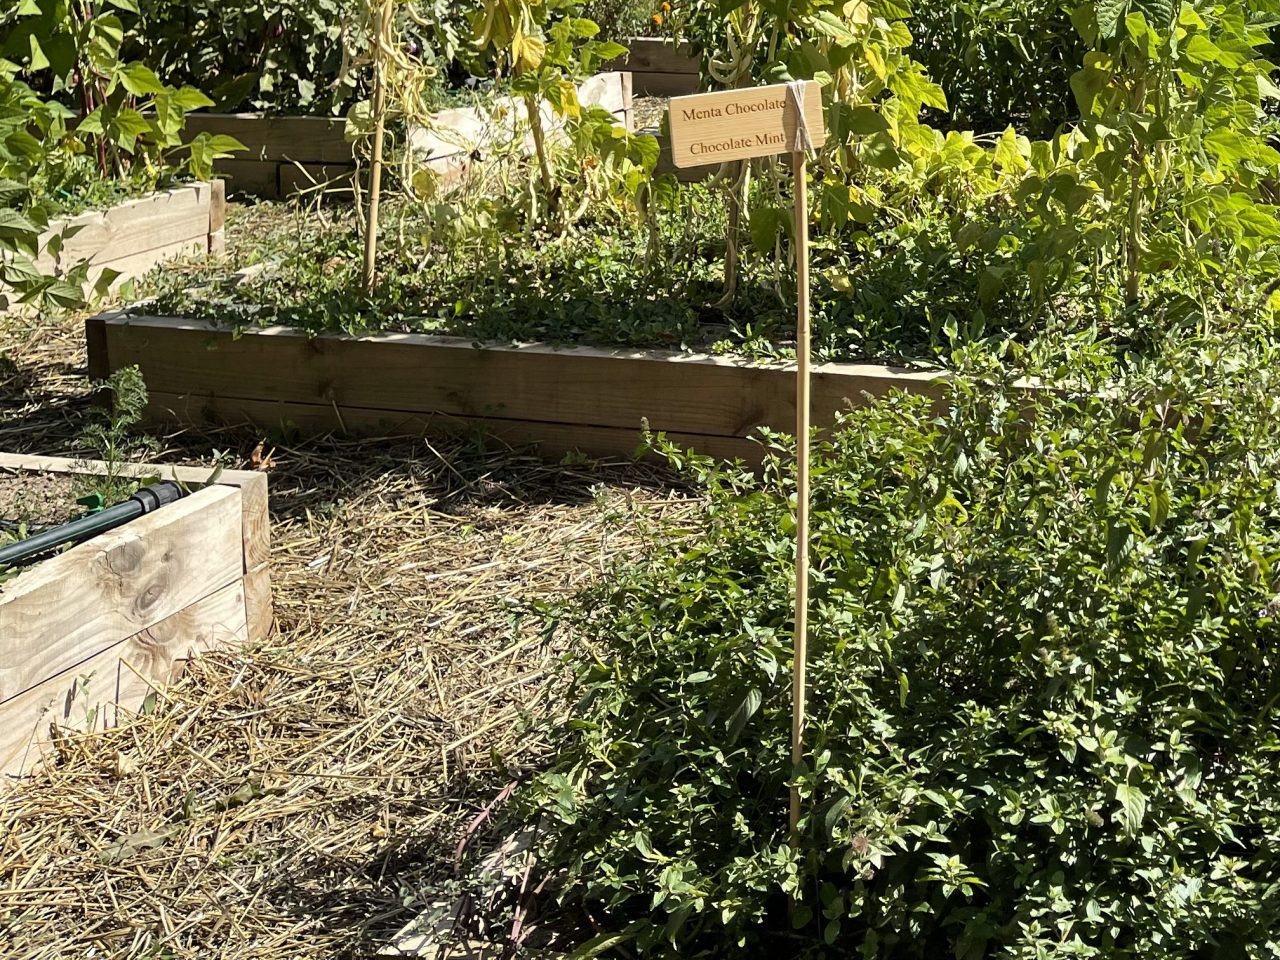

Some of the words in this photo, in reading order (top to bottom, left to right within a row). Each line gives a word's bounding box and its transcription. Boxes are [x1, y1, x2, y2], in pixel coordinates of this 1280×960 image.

[682, 107, 722, 121] Menta
[725, 99, 786, 116] Chocolate
[690, 138, 751, 155] Chocolate
[755, 133, 785, 145] Mint
